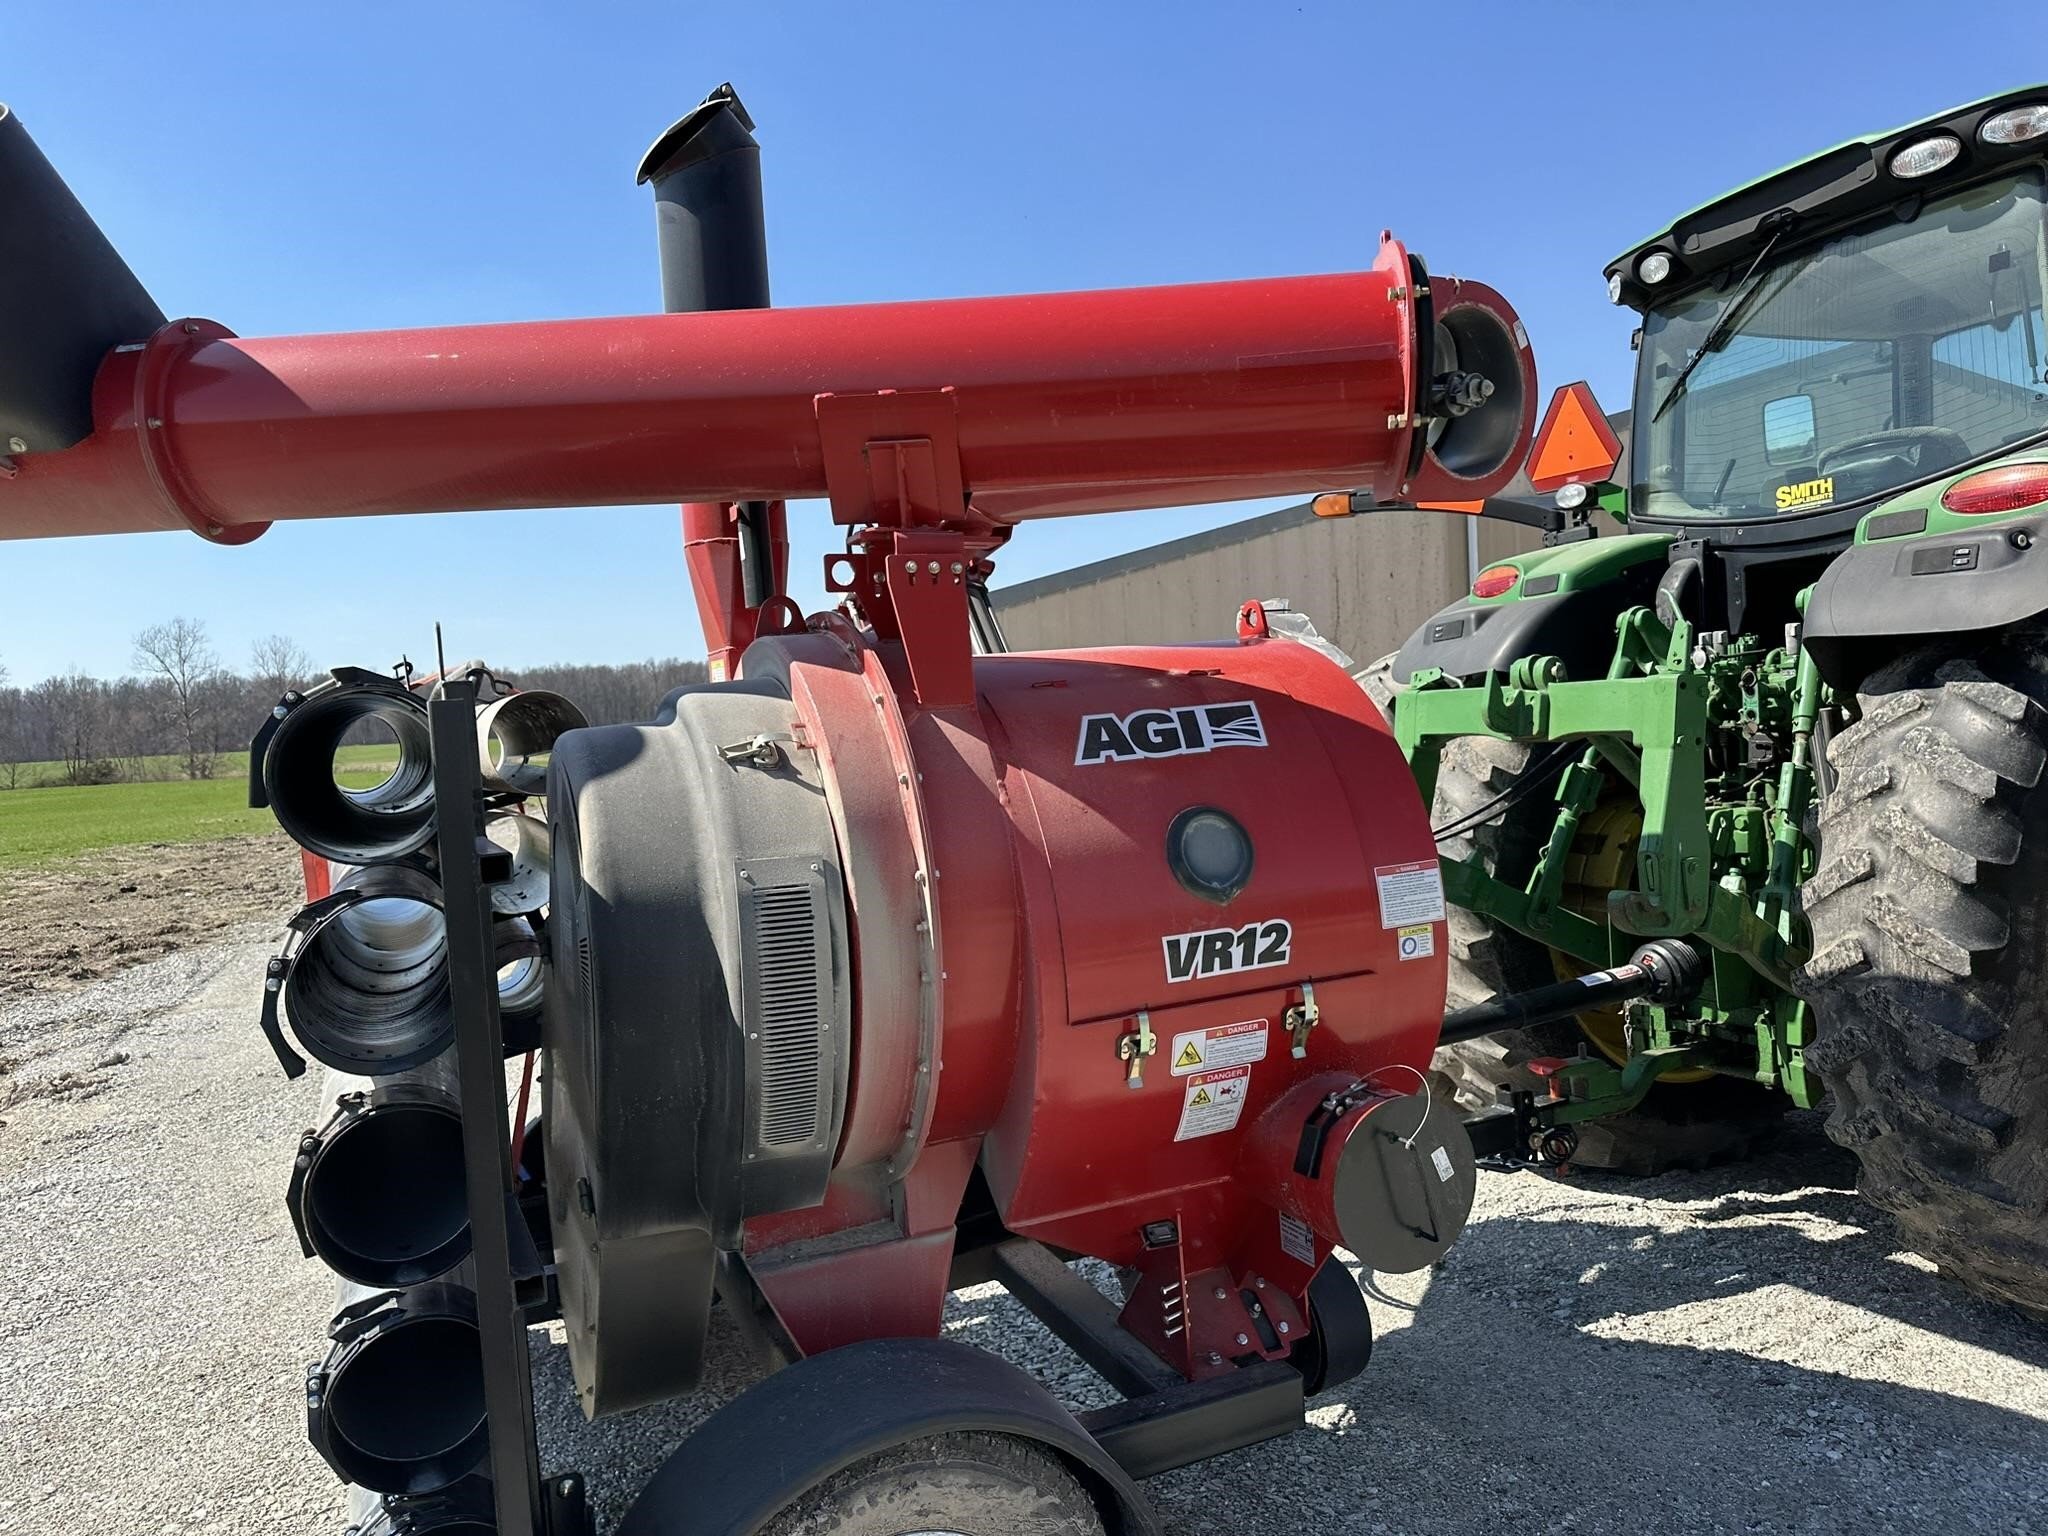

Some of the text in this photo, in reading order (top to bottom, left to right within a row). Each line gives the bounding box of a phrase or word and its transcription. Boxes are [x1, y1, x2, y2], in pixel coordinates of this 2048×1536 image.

[1776, 477, 1833, 508] SMITH
[1081, 709, 1205, 760] AGI
[1408, 927, 1429, 935] CAUTION
[1166, 922, 1287, 979] VR12
[1227, 1023, 1259, 1035] DANGER
[1206, 1069, 1243, 1082] DANGER
